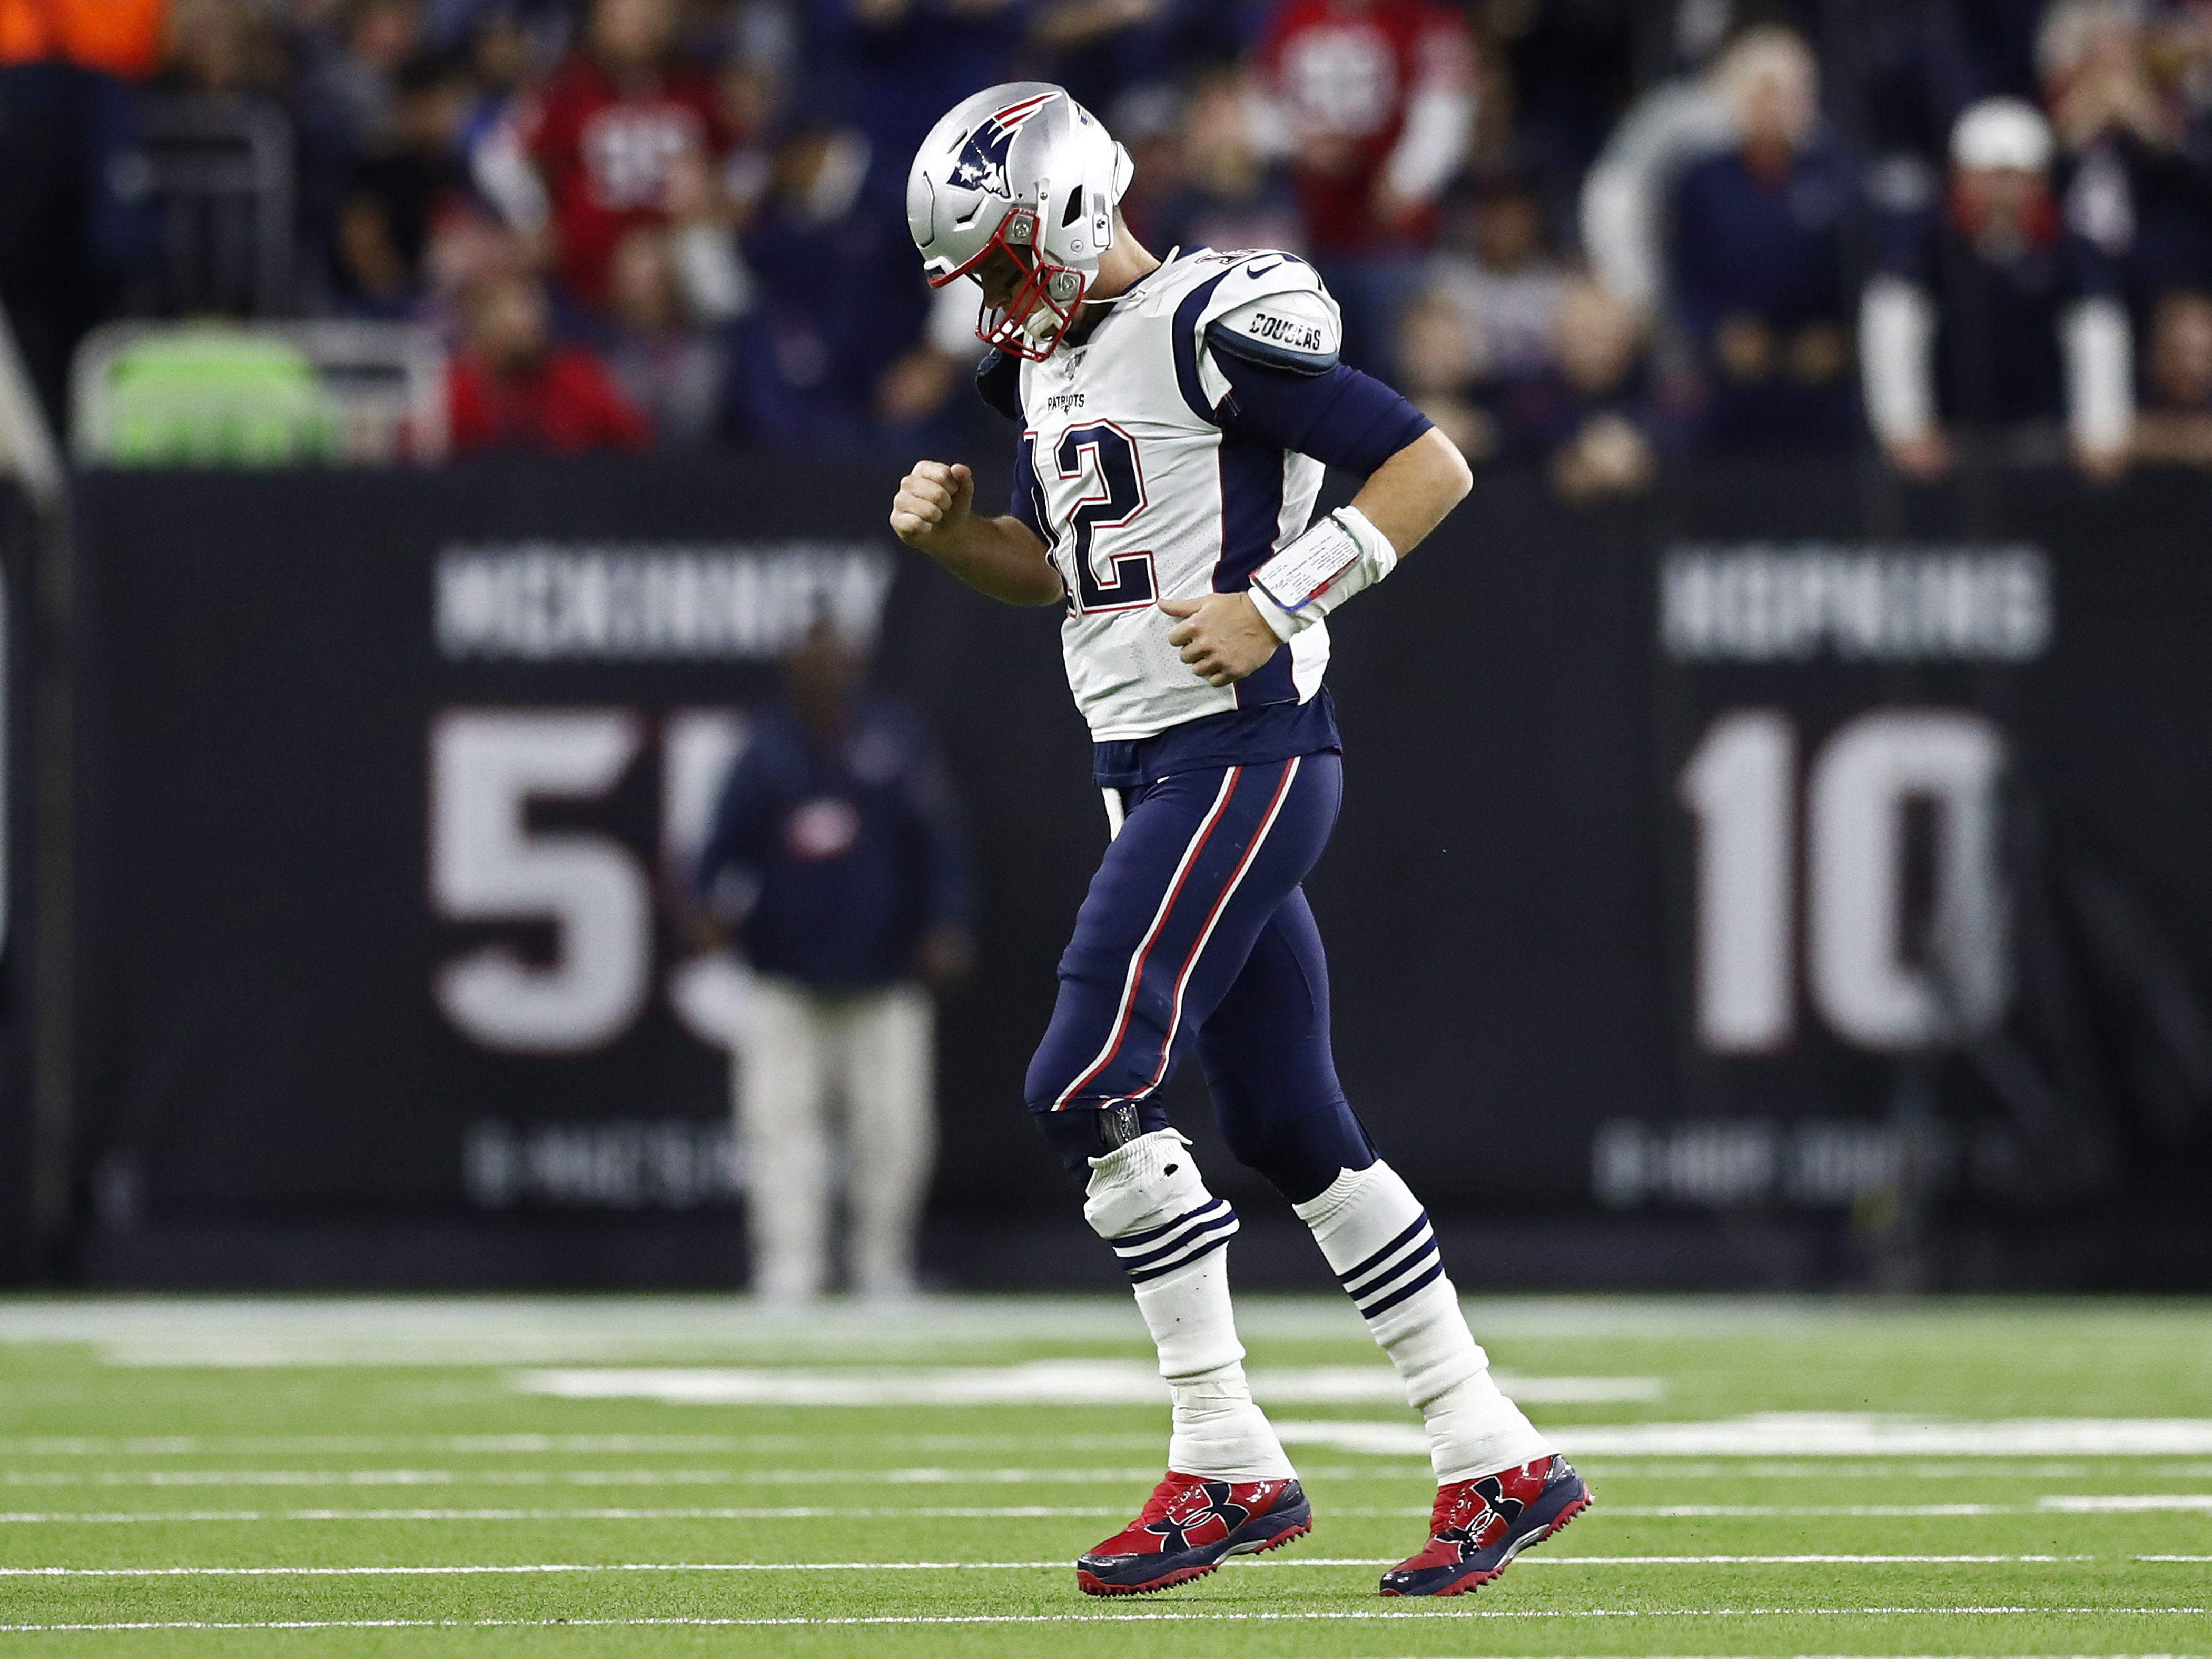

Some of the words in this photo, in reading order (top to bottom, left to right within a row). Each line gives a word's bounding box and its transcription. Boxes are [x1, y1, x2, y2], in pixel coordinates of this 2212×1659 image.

[1047, 393, 1085, 412] PATRIOTS
[1659, 542, 2053, 661] HOPKINS
[1678, 706, 2011, 1051] 10
